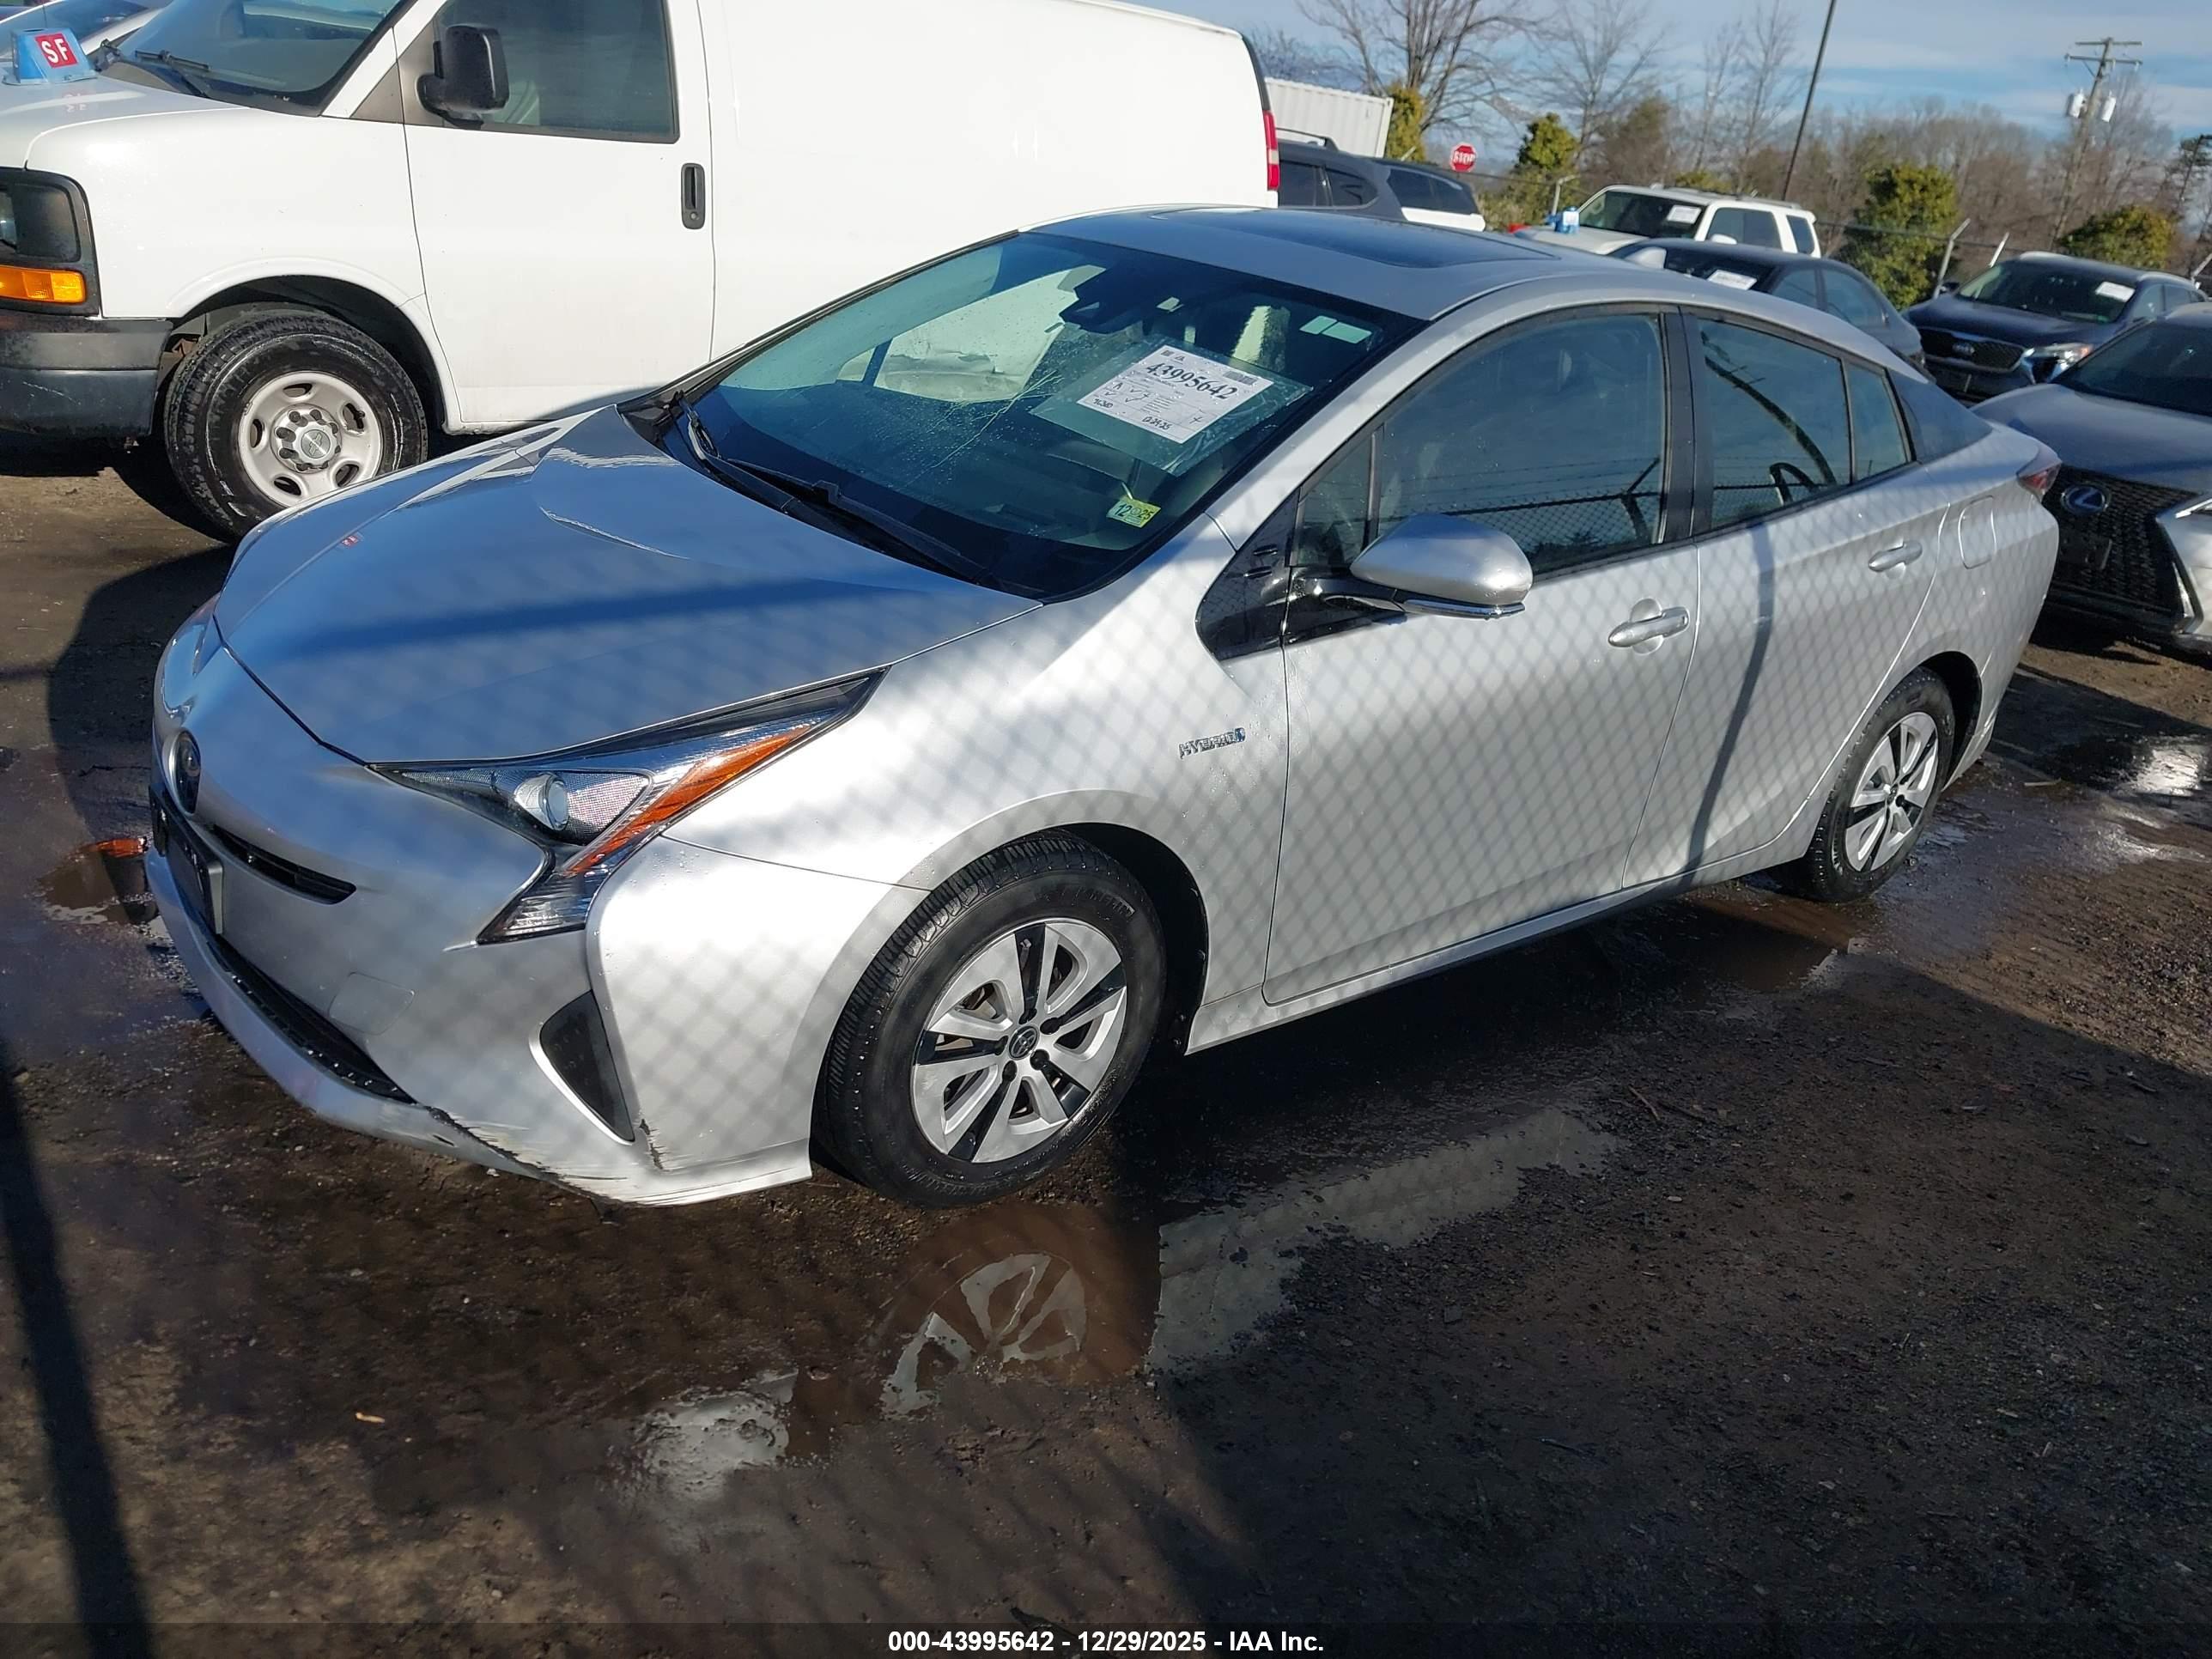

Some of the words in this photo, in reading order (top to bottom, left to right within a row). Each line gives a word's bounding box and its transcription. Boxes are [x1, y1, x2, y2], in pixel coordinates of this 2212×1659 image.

[41, 38, 69, 64] SF
[1452, 150, 1476, 166] STOP
[1146, 362, 1238, 399] 43995642
[1114, 503, 1133, 517] 12
